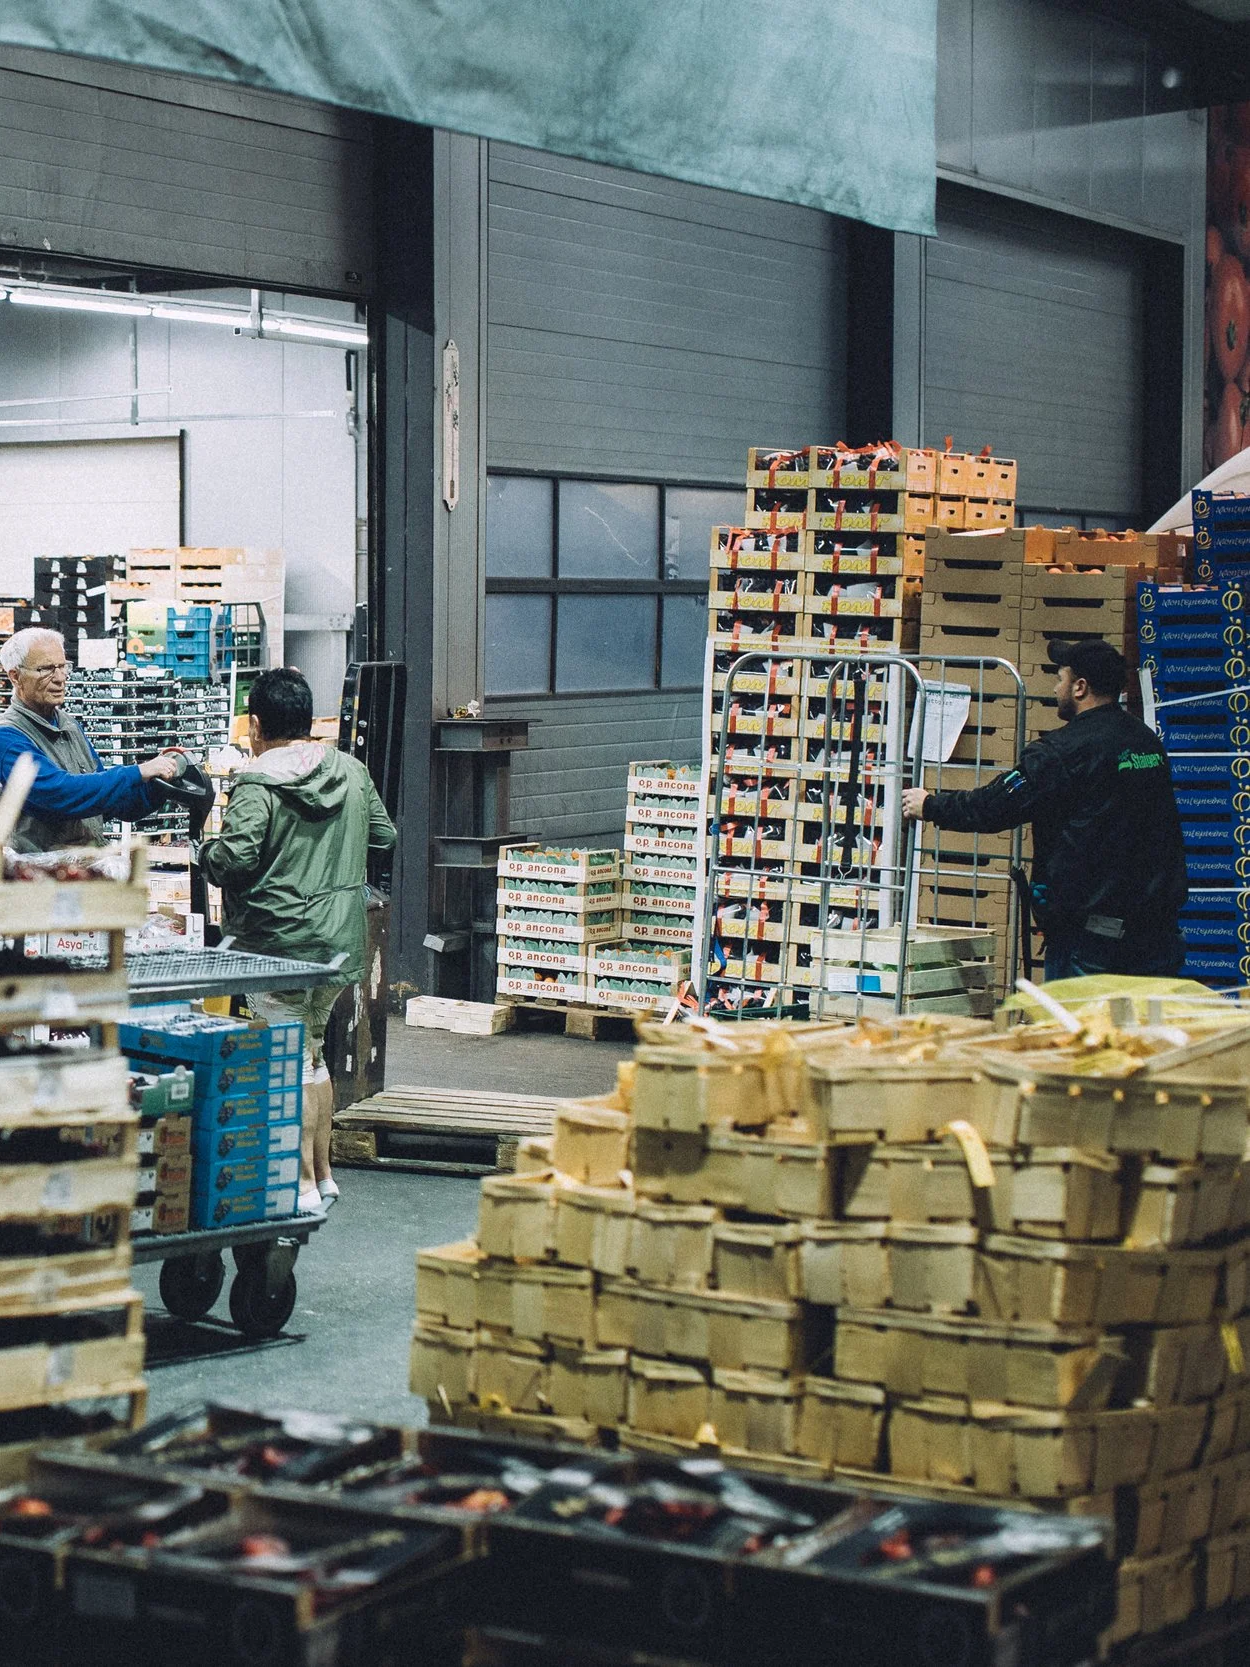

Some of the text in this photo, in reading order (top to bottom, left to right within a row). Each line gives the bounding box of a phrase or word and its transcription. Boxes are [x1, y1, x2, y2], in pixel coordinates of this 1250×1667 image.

[657, 780, 696, 791] ancona
[657, 810, 696, 820] ancona
[654, 839, 693, 850] ancona
[527, 865, 566, 874] ancona
[654, 869, 693, 880] ancona
[526, 894, 565, 904] ancona
[652, 898, 691, 909] ancona
[526, 924, 565, 934] ancona
[653, 928, 692, 938] ancona
[527, 954, 566, 964] ancona
[618, 964, 658, 974] ancona
[527, 983, 566, 993] ancona
